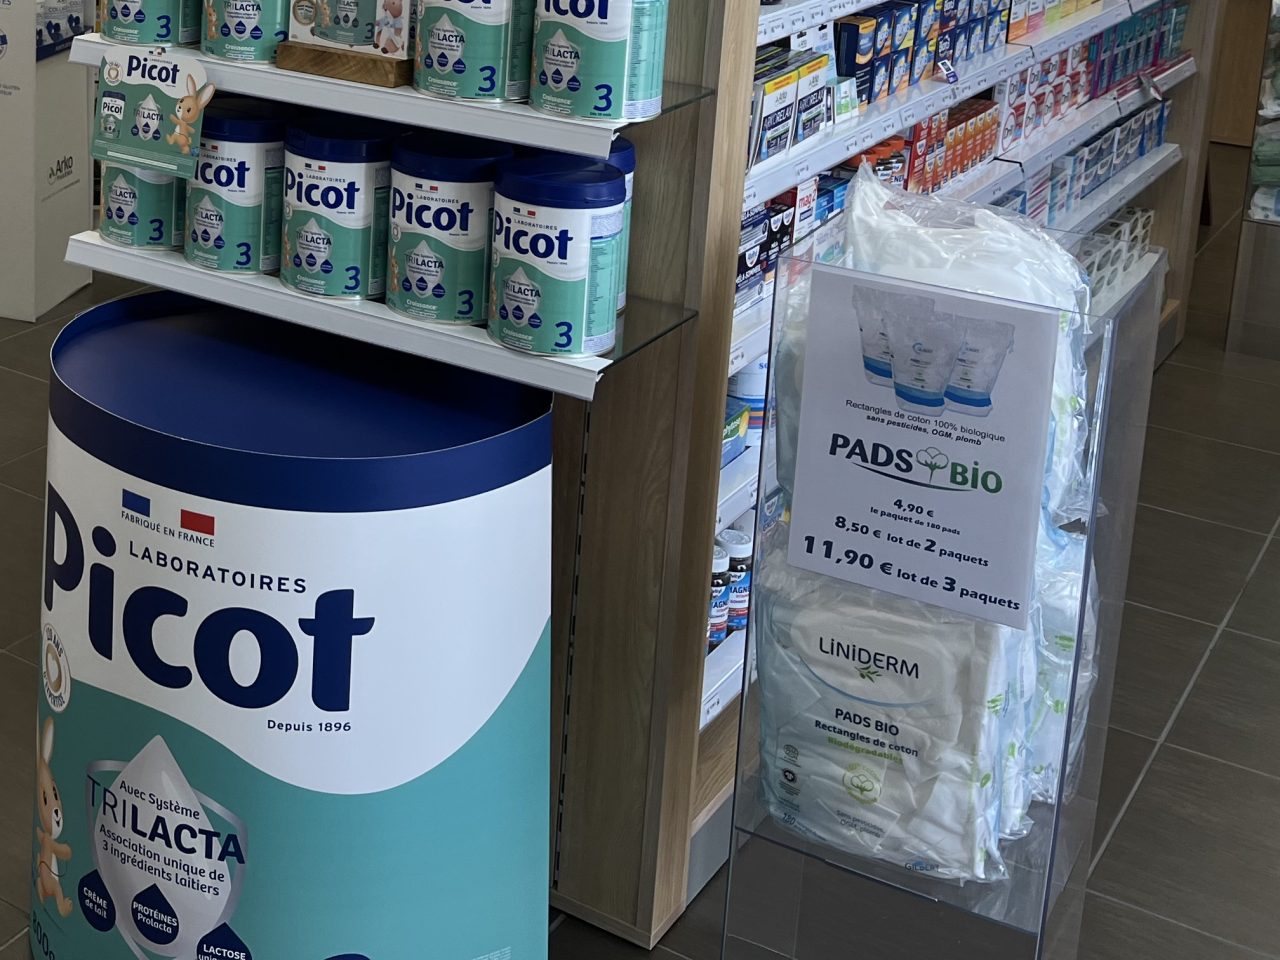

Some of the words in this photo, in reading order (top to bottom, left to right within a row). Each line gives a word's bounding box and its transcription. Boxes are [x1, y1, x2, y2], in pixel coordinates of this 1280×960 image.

[156, 15, 172, 39] 3
[126, 54, 181, 85] Picot
[478, 65, 497, 93] 3
[593, 83, 613, 112] 3
[56, 154, 74, 174] Arko
[195, 160, 251, 189] cot
[284, 166, 360, 210] Picot
[391, 186, 474, 232] Picot
[148, 218, 165, 242] 3
[493, 210, 574, 261] Picot
[235, 241, 252, 266] 3
[344, 265, 361, 291] 3
[456, 289, 474, 316] 3
[845, 398, 893, 419] Rectangles
[894, 411, 906, 421] de
[907, 415, 932, 427] coton
[934, 419, 958, 432] 100%
[960, 423, 1006, 444] biologique
[866, 414, 886, 425] sans
[886, 418, 929, 436] pesticides,
[931, 428, 954, 441] OGM,
[955, 433, 983, 446] plomb
[828, 433, 914, 474] PADS
[870, 506, 879, 514] le
[880, 510, 913, 525] paquet
[914, 517, 925, 526] de
[942, 524, 961, 536] pads
[893, 498, 924, 517] 4,90
[926, 509, 935, 518] €
[121, 510, 161, 533] FABRIQUÉ
[163, 522, 176, 538] EN
[178, 530, 216, 548] FRANCE
[834, 515, 870, 536] 8,50
[872, 528, 882, 539] €
[886, 532, 904, 545] lot
[905, 537, 922, 550] de
[923, 538, 937, 553] 2
[939, 546, 990, 568] paquets
[129, 540, 307, 594] LABORATOIRES
[803, 534, 875, 571] 11,90
[879, 561, 893, 577] €
[896, 567, 918, 582] lot
[919, 573, 939, 589] de
[942, 575, 957, 592] 3
[959, 585, 1021, 612] paquets
[44, 480, 376, 712] Picot
[267, 719, 313, 733] Depuis
[318, 722, 351, 732] 1896
[834, 707, 872, 729] PADS
[874, 718, 900, 736] BIO
[814, 719, 871, 745] Rectangles
[872, 735, 886, 747] de
[888, 741, 919, 757] coton
[119, 779, 146, 801] Avec
[148, 792, 201, 821] Système
[86, 774, 246, 865] TRILACTA
[99, 823, 161, 863] Association
[163, 856, 207, 878] unique
[208, 868, 225, 883] de
[102, 840, 109, 851] 3
[110, 842, 173, 883] ingrédients
[175, 873, 220, 896] laitiers
[83, 886, 108, 910] CRÈME
[84, 898, 94, 911] de
[94, 903, 107, 919] lait
[132, 900, 178, 927] PROTÉINES
[137, 912, 173, 934] Prolacta
[203, 943, 246, 960] LACTOSE
